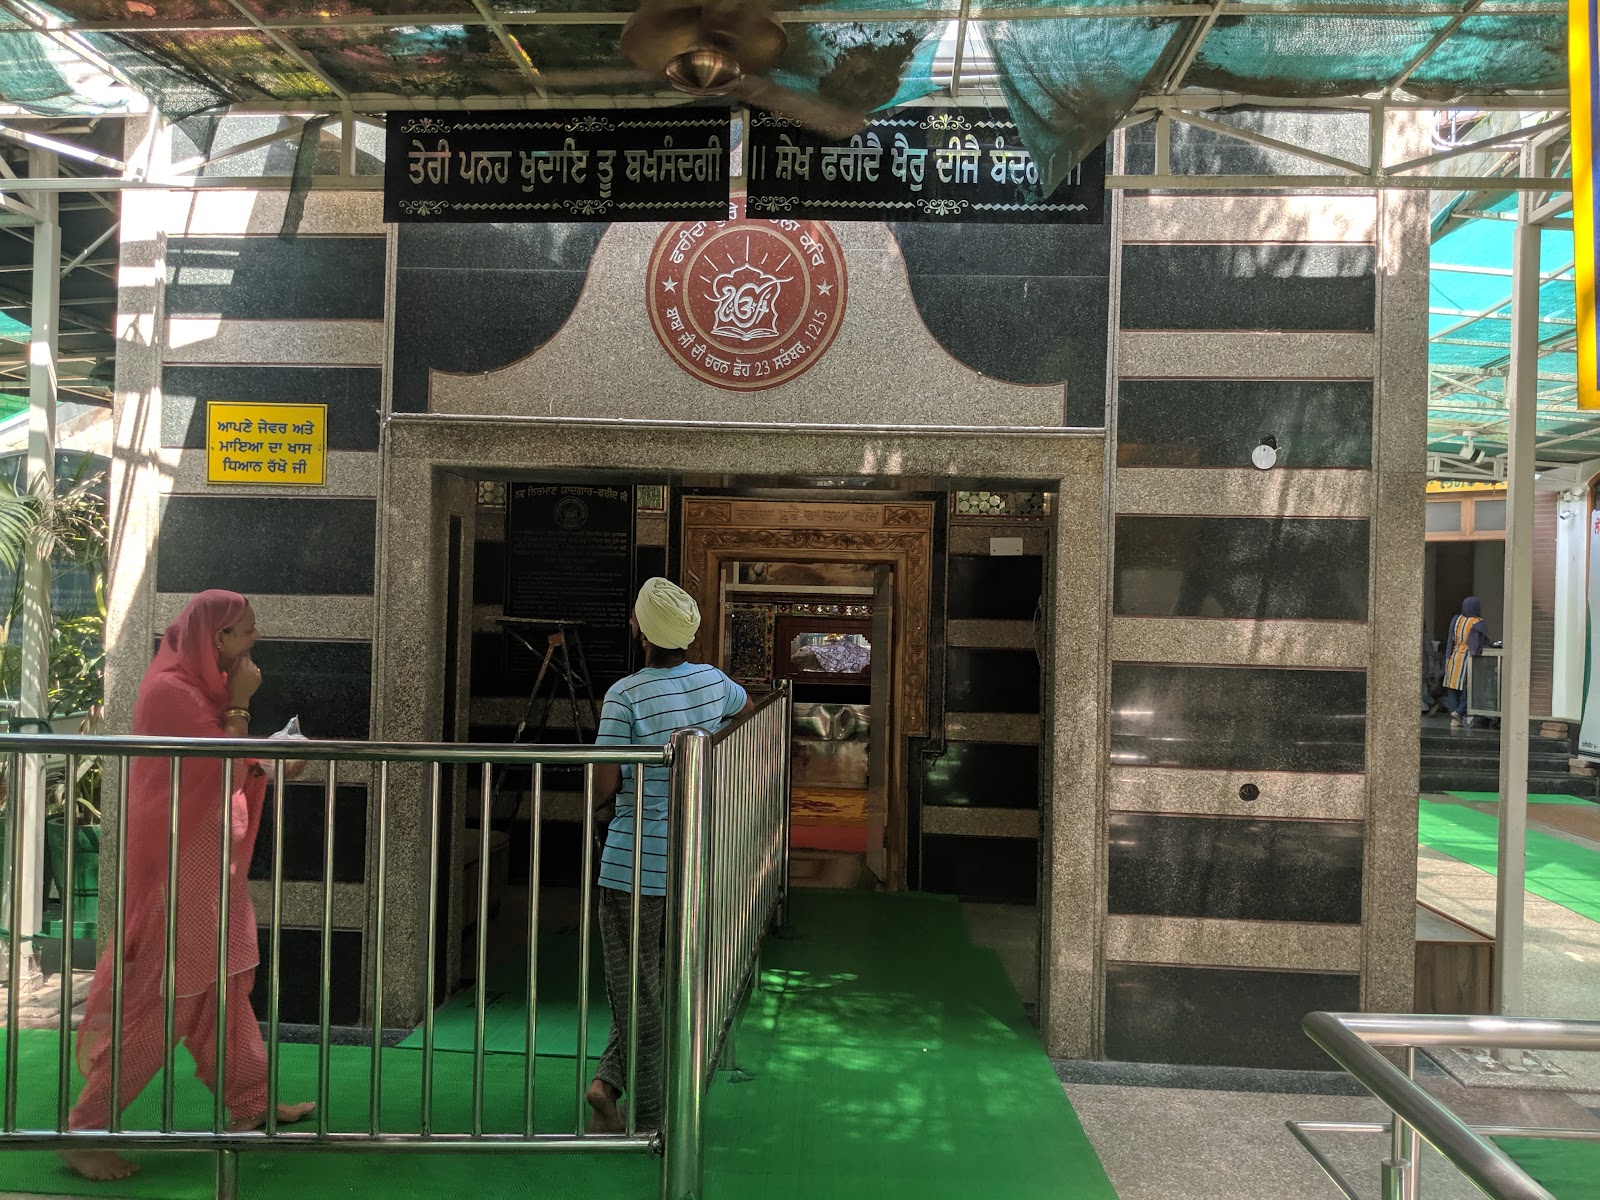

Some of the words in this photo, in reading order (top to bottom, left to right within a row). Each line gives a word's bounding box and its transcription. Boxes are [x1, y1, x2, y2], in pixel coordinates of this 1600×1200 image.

[408, 138, 452, 185] ਤੇਰੀ
[458, 150, 513, 185] ਪਨਹ
[519, 137, 590, 193] ਖੁਦਾਇ
[597, 150, 616, 198] ਤੂ
[624, 135, 723, 185] ਬਖਸੰਦਗੀ
[821, 132, 884, 183] ਫਰੀਦੈ
[891, 132, 927, 192] ਖੈਰੁ
[935, 133, 982, 184] ਦੀਜੈ
[666, 305, 686, 331] ਬਾਬਾ
[677, 330, 697, 349] ਜੀ
[690, 343, 707, 361] ਦੀ
[704, 353, 731, 374] ਚਰਨ
[732, 357, 752, 377] ਛੋਹ
[754, 359, 771, 377] 23
[805, 309, 828, 341] 1215
[217, 418, 253, 433] ਆਪਣੇ
[258, 418, 288, 434] ਜੇਵਰ
[292, 420, 315, 435] ਅਤੇ
[219, 437, 264, 453] ਮਾਇਆ
[268, 441, 282, 453] ਦਾ
[287, 442, 313, 455] ਖਾਸ
[223, 456, 263, 472] ਧਿਆਨ
[267, 458, 288, 473] ਰੱਖੋ
[292, 458, 308, 474] ਜੀ
